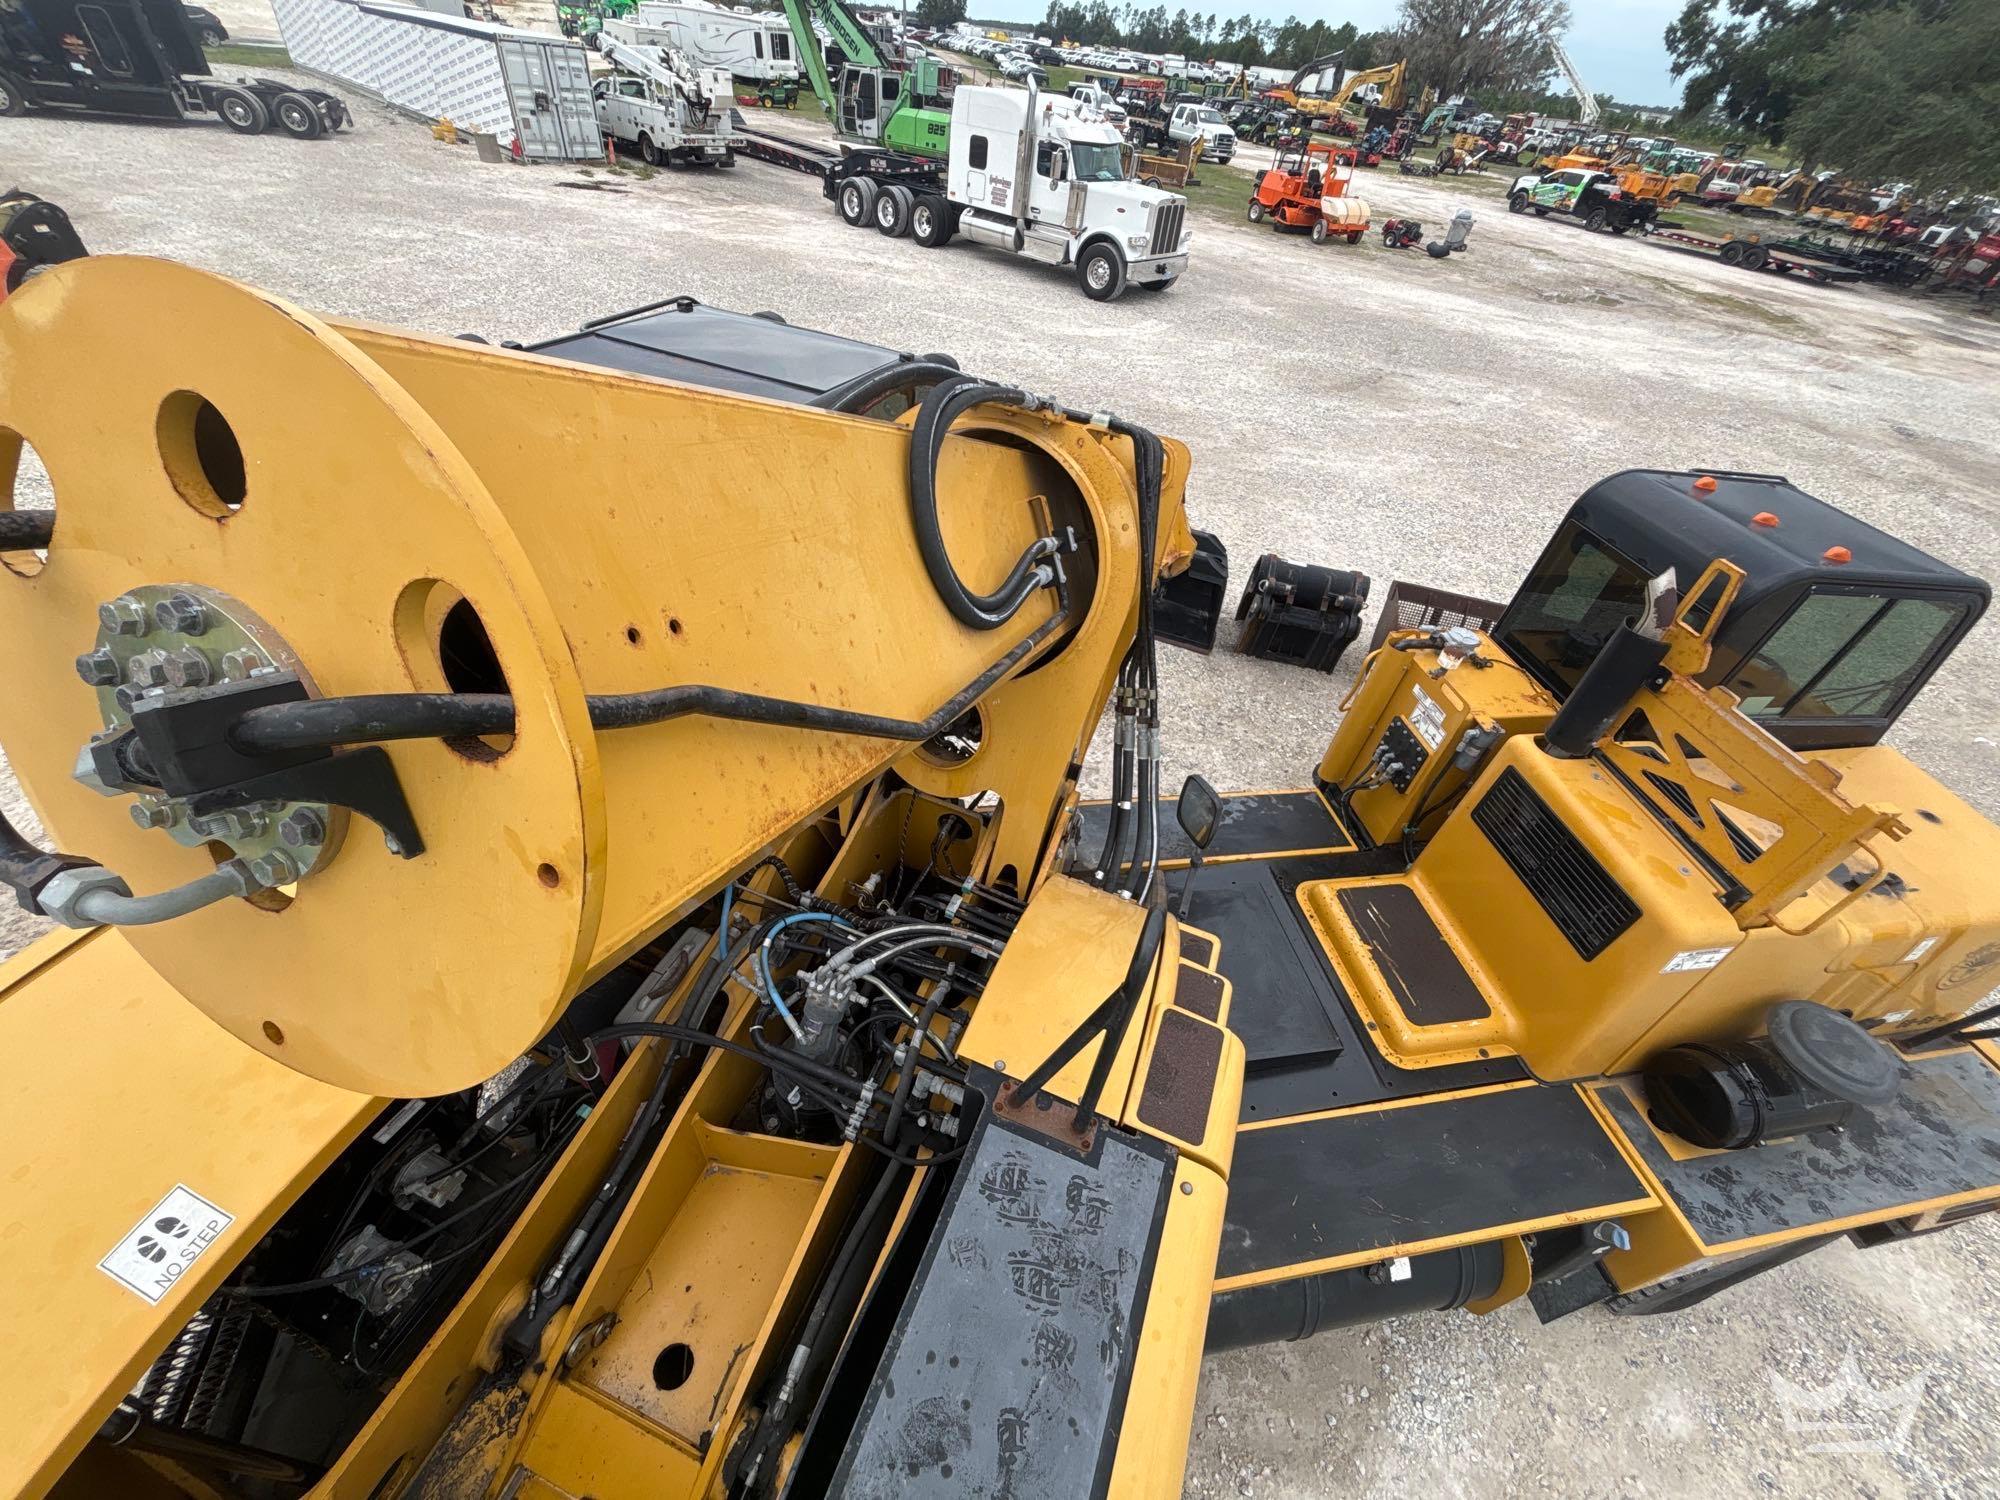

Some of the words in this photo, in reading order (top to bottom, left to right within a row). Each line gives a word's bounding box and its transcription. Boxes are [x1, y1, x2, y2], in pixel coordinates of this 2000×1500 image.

[927, 122, 946, 136] 825
[154, 1263, 182, 1289] NO
[180, 1220, 218, 1262] STEP
